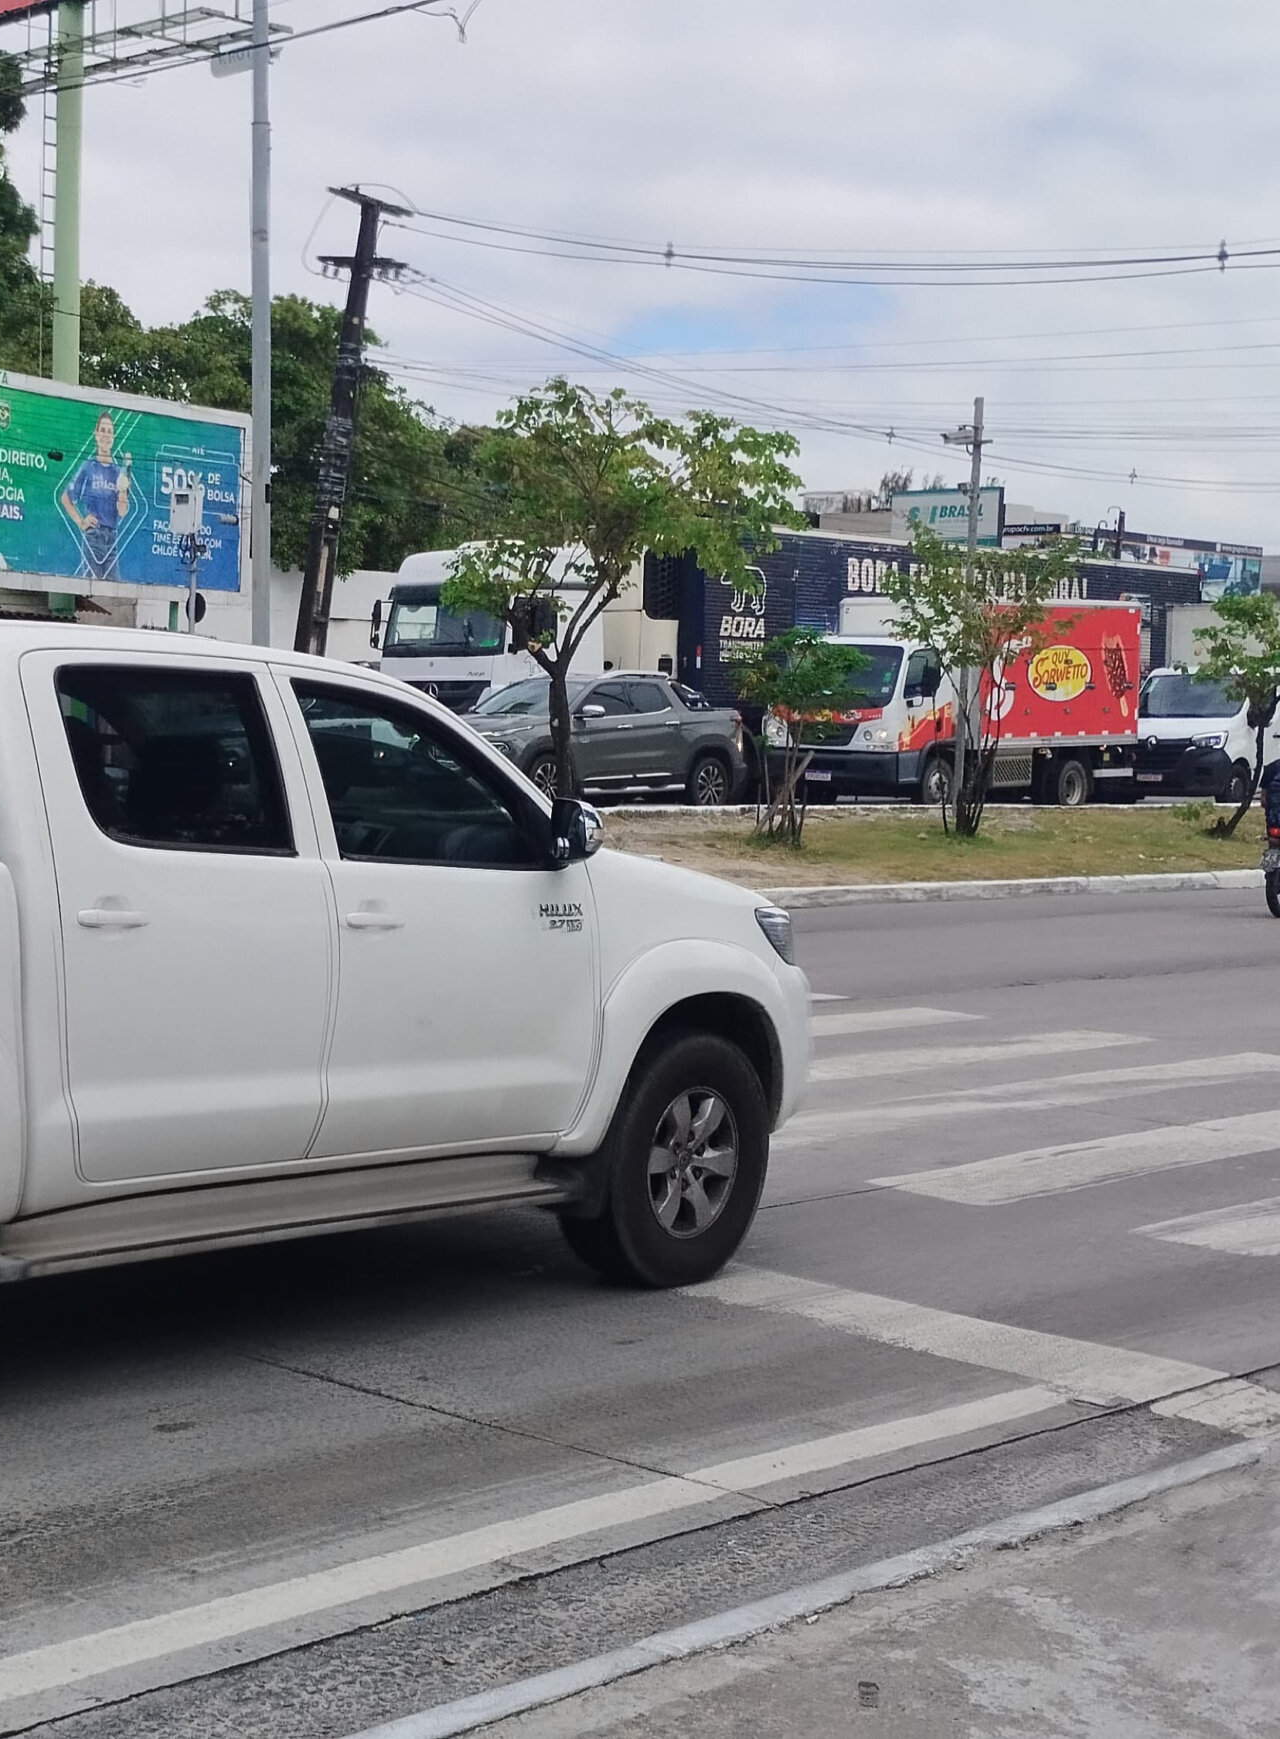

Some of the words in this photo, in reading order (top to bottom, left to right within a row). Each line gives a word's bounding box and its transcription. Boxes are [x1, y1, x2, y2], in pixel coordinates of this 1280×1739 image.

[207, 472, 222, 486] DE
[207, 489, 236, 504] BOLSA
[939, 503, 985, 519] BRASL
[153, 519, 173, 533] FAÇ
[719, 615, 766, 638] BORA
[539, 902, 584, 918] HILUX
